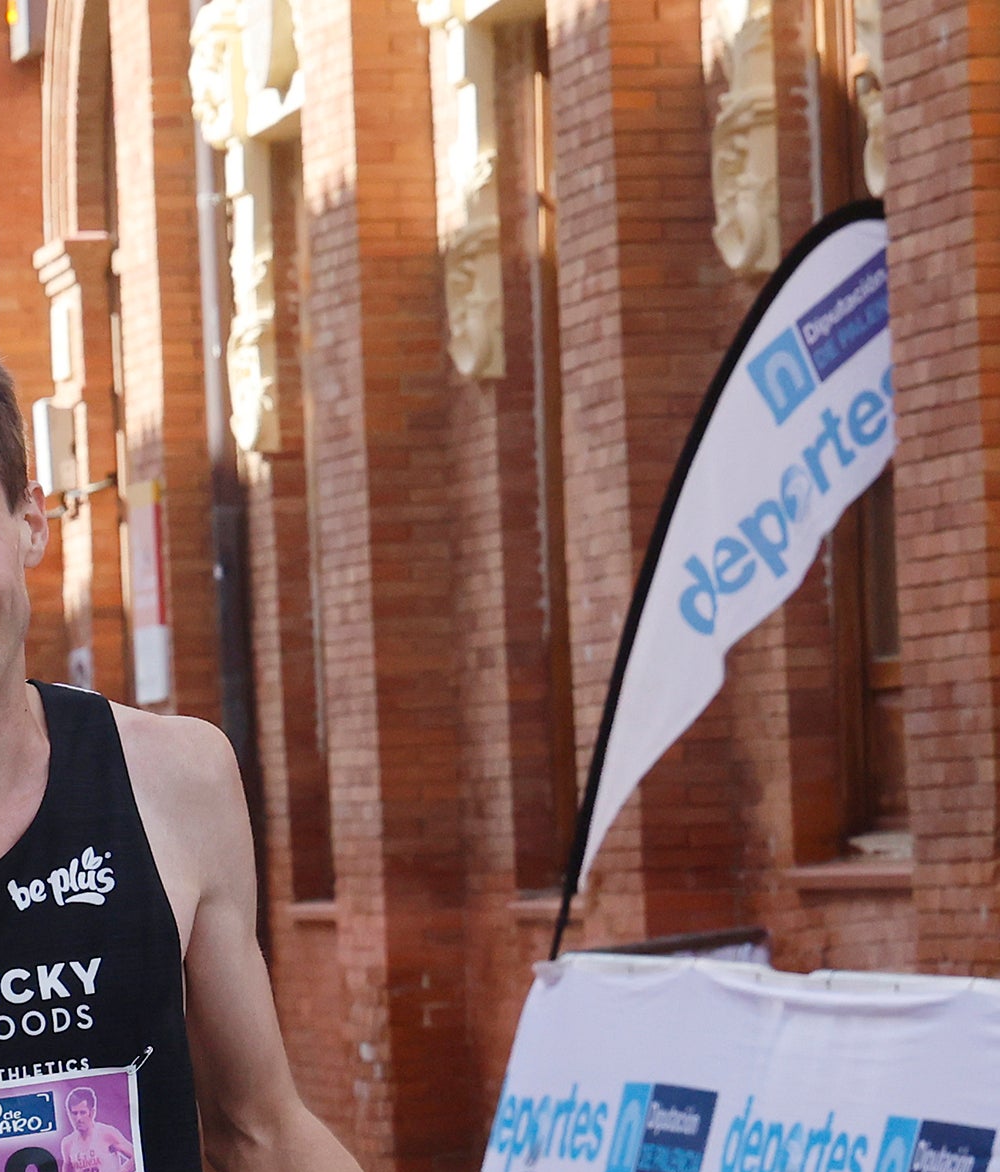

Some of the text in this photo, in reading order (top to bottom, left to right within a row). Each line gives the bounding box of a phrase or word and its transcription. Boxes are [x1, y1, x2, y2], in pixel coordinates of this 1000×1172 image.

[7, 847, 116, 911] be plus
[3, 1110, 22, 1121] de
